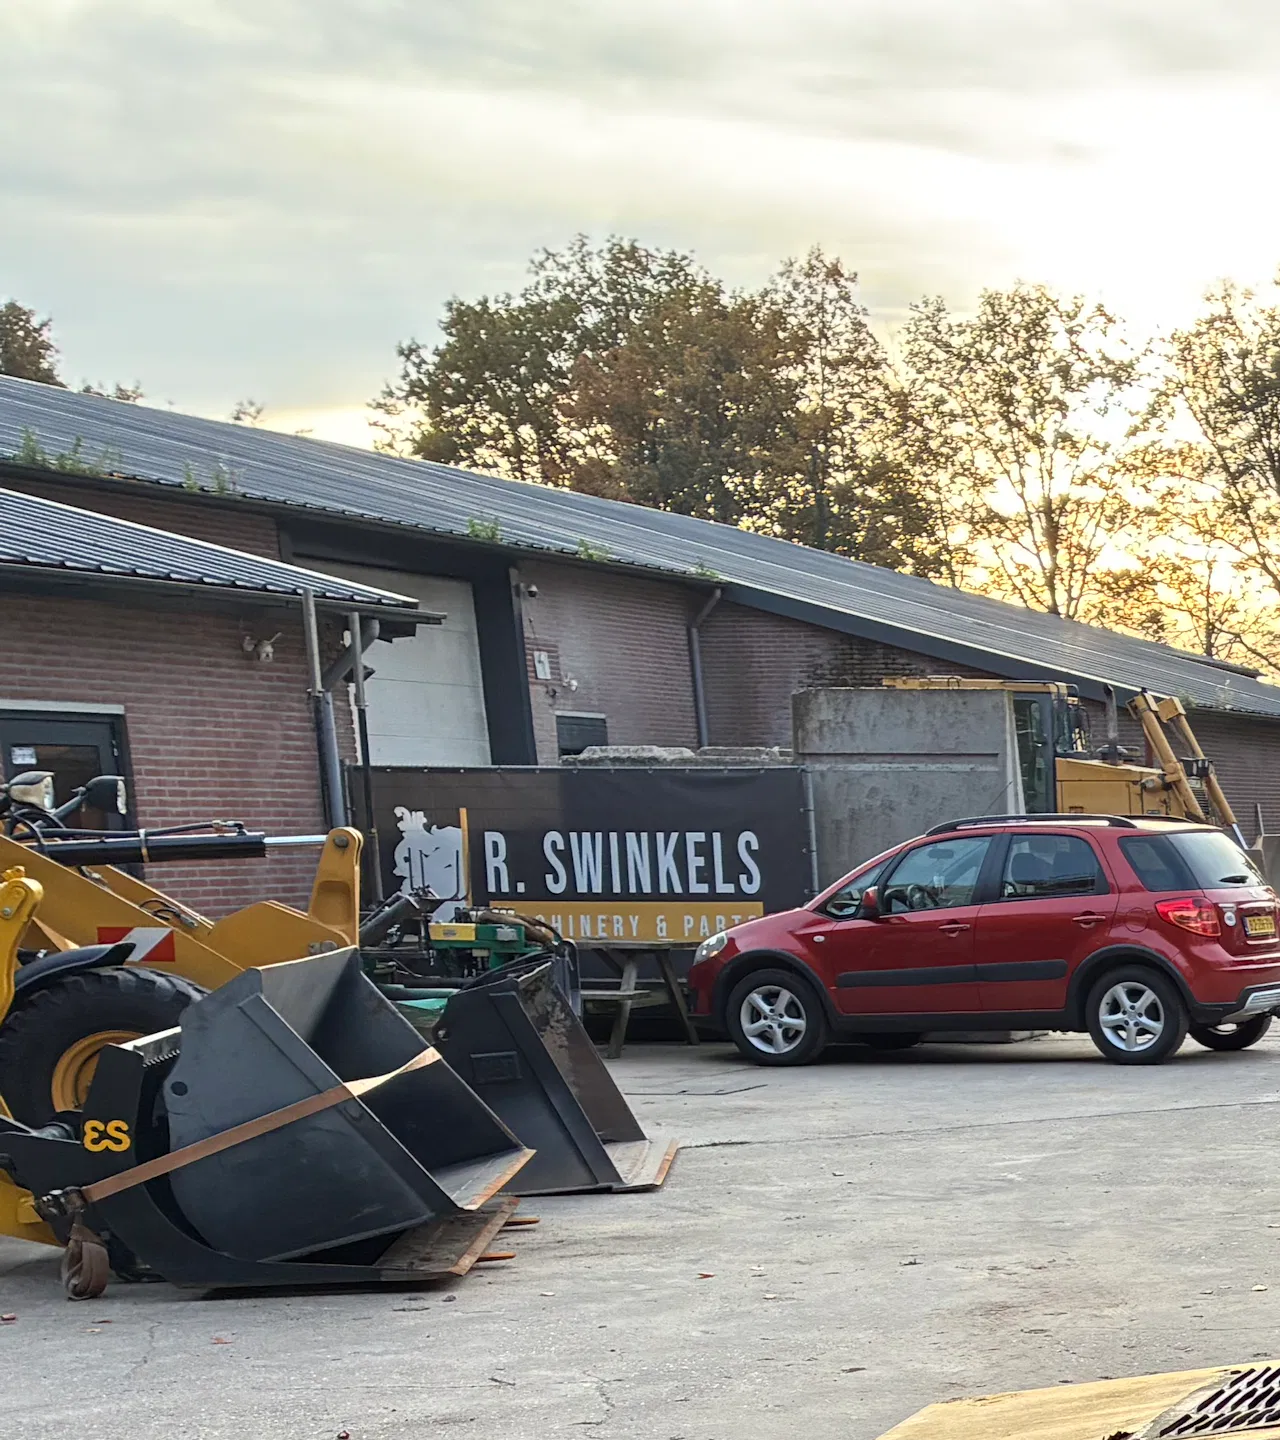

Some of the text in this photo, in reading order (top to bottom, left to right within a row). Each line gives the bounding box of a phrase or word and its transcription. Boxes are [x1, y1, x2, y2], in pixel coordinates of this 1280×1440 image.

[484, 831, 761, 894] R. SWINKELS
[656, 914, 668, 938] &
